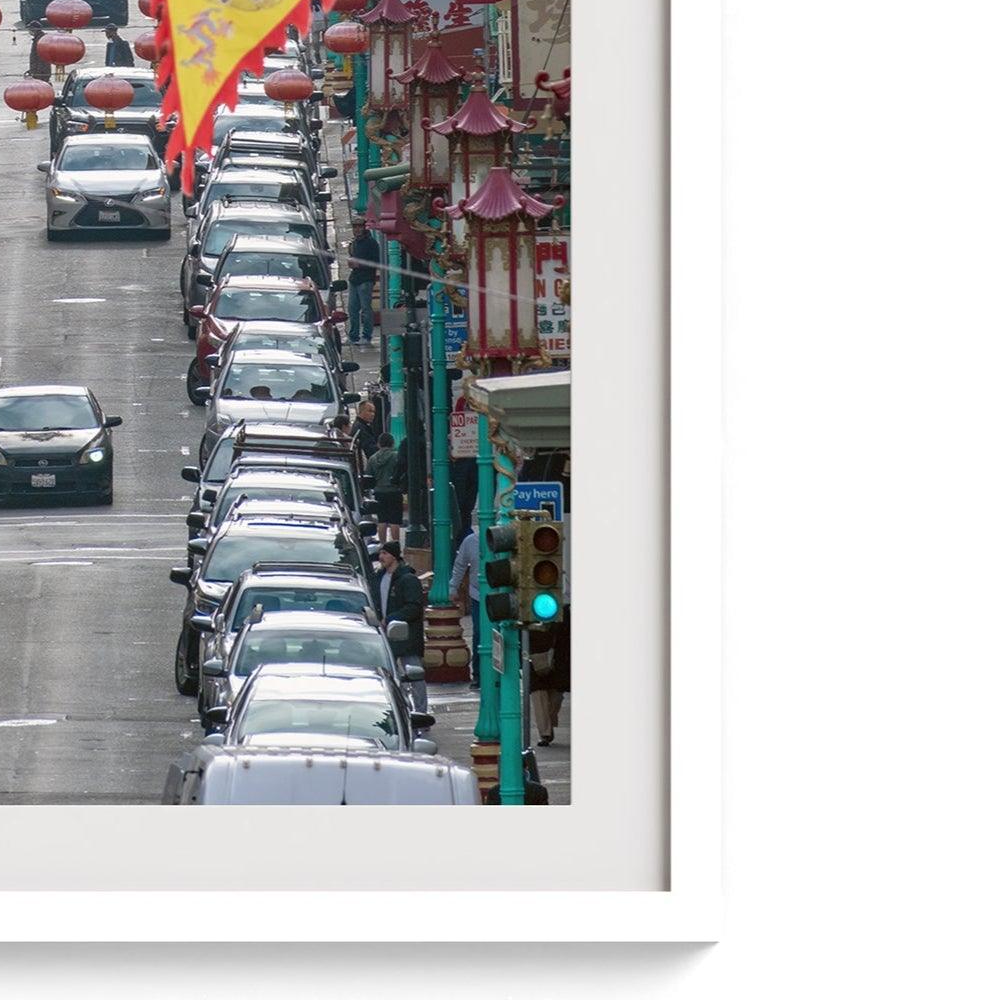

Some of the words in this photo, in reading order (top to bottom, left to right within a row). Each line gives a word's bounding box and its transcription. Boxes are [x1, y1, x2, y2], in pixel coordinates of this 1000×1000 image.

[452, 415, 465, 426] NO
[512, 489, 532, 501] Pay
[534, 489, 558, 499] here
